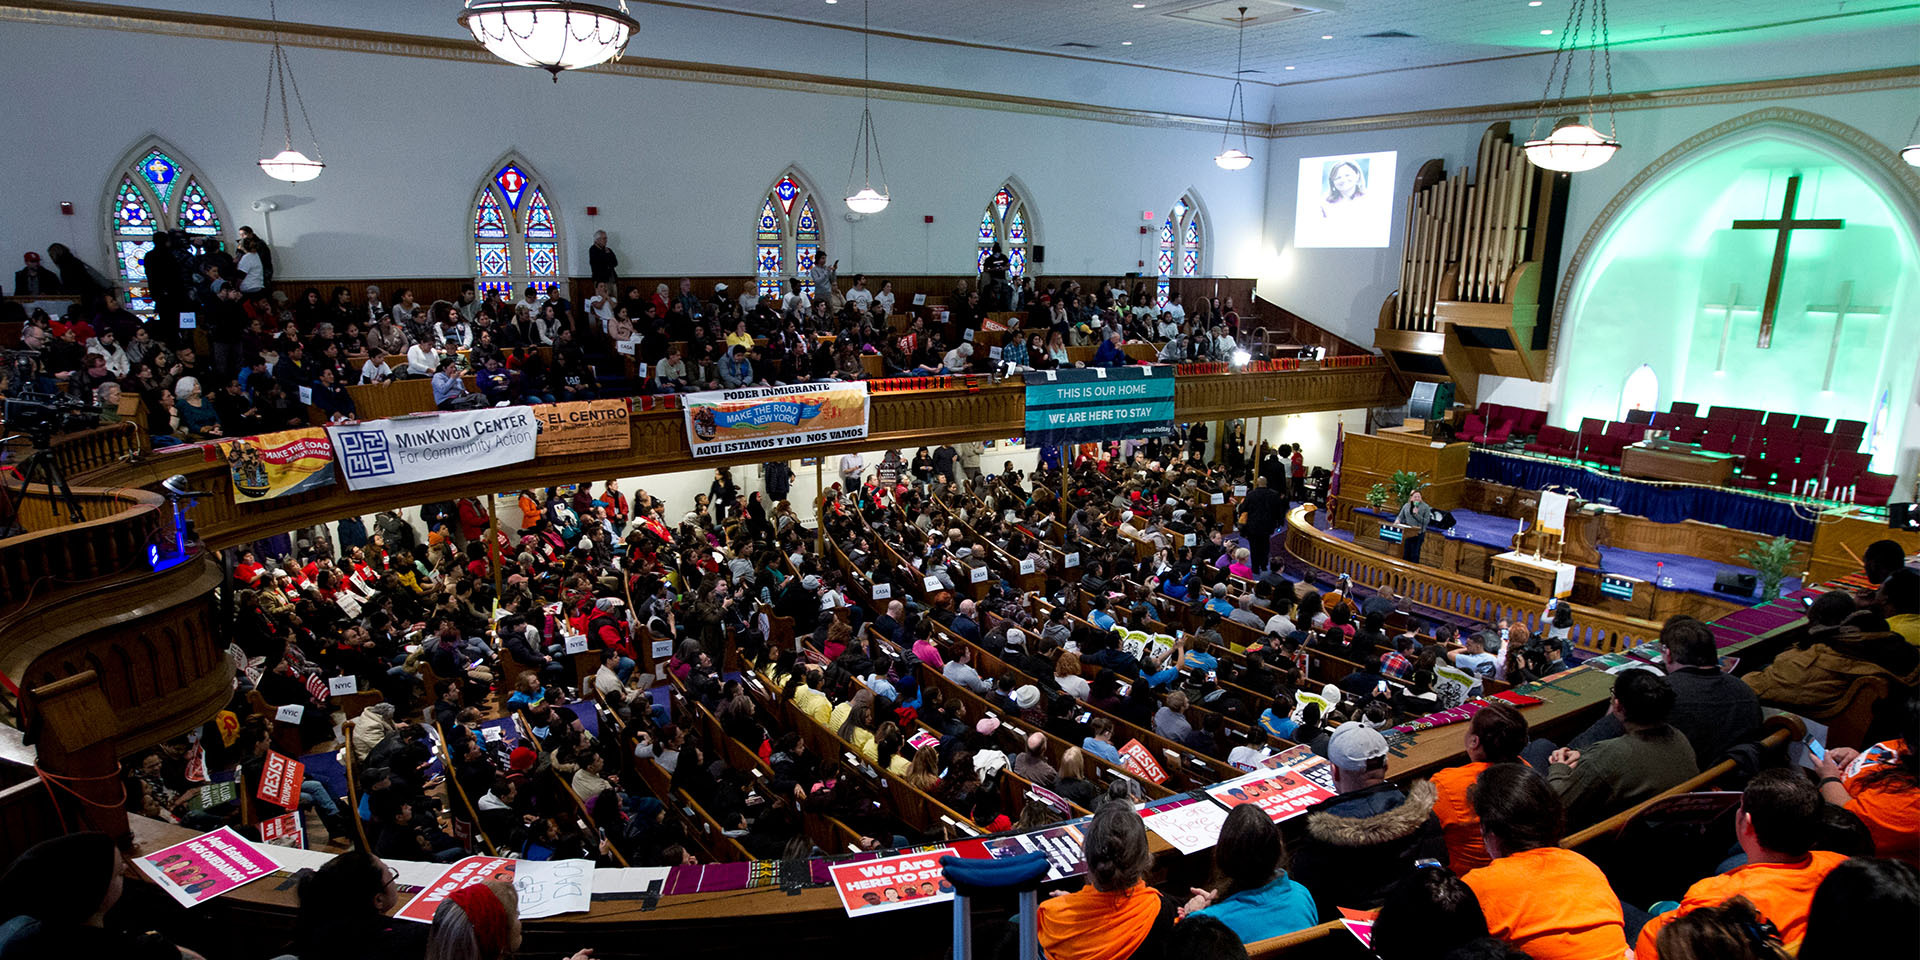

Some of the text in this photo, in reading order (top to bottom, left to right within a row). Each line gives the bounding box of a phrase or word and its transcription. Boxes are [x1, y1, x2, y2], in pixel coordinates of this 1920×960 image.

[723, 383, 830, 401] PODER INMIGRANTE
[1057, 384, 1147, 399] THIS IS OUR HOME
[547, 407, 627, 424] EL CENTRO
[726, 409, 752, 424] MAKE
[754, 405, 773, 416] THE
[774, 404, 798, 415] ROAD
[753, 413, 797, 424] NEW YORK
[1048, 407, 1153, 424] WE ARE HERE TO STAY
[265, 440, 331, 460] MAKE THE ROAD
[398, 449, 420, 465] For
[422, 437, 492, 461] Community
[495, 430, 533, 448] Action
[696, 441, 723, 456] AQUÍ
[724, 438, 775, 453] ESTAMOS
[775, 436, 785, 446] Y
[786, 435, 802, 445] NO
[806, 431, 828, 442] NOS
[828, 428, 864, 440] VAMOS
[570, 640, 585, 648] NYIC
[334, 682, 352, 690] NYIC
[281, 709, 299, 718] NYIC
[286, 760, 297, 782] HATE
[1127, 744, 1166, 782] RESIST
[261, 753, 286, 798] RESIST
[1264, 795, 1321, 816] We Are
[186, 841, 248, 883] NOS QUEDAMOS!
[221, 846, 257, 870] Estamos
[247, 867, 263, 875] y
[858, 859, 936, 878] We Are
[422, 861, 483, 902] We Are
[552, 861, 584, 899] DACA
[845, 867, 944, 892] HERE TO STA
